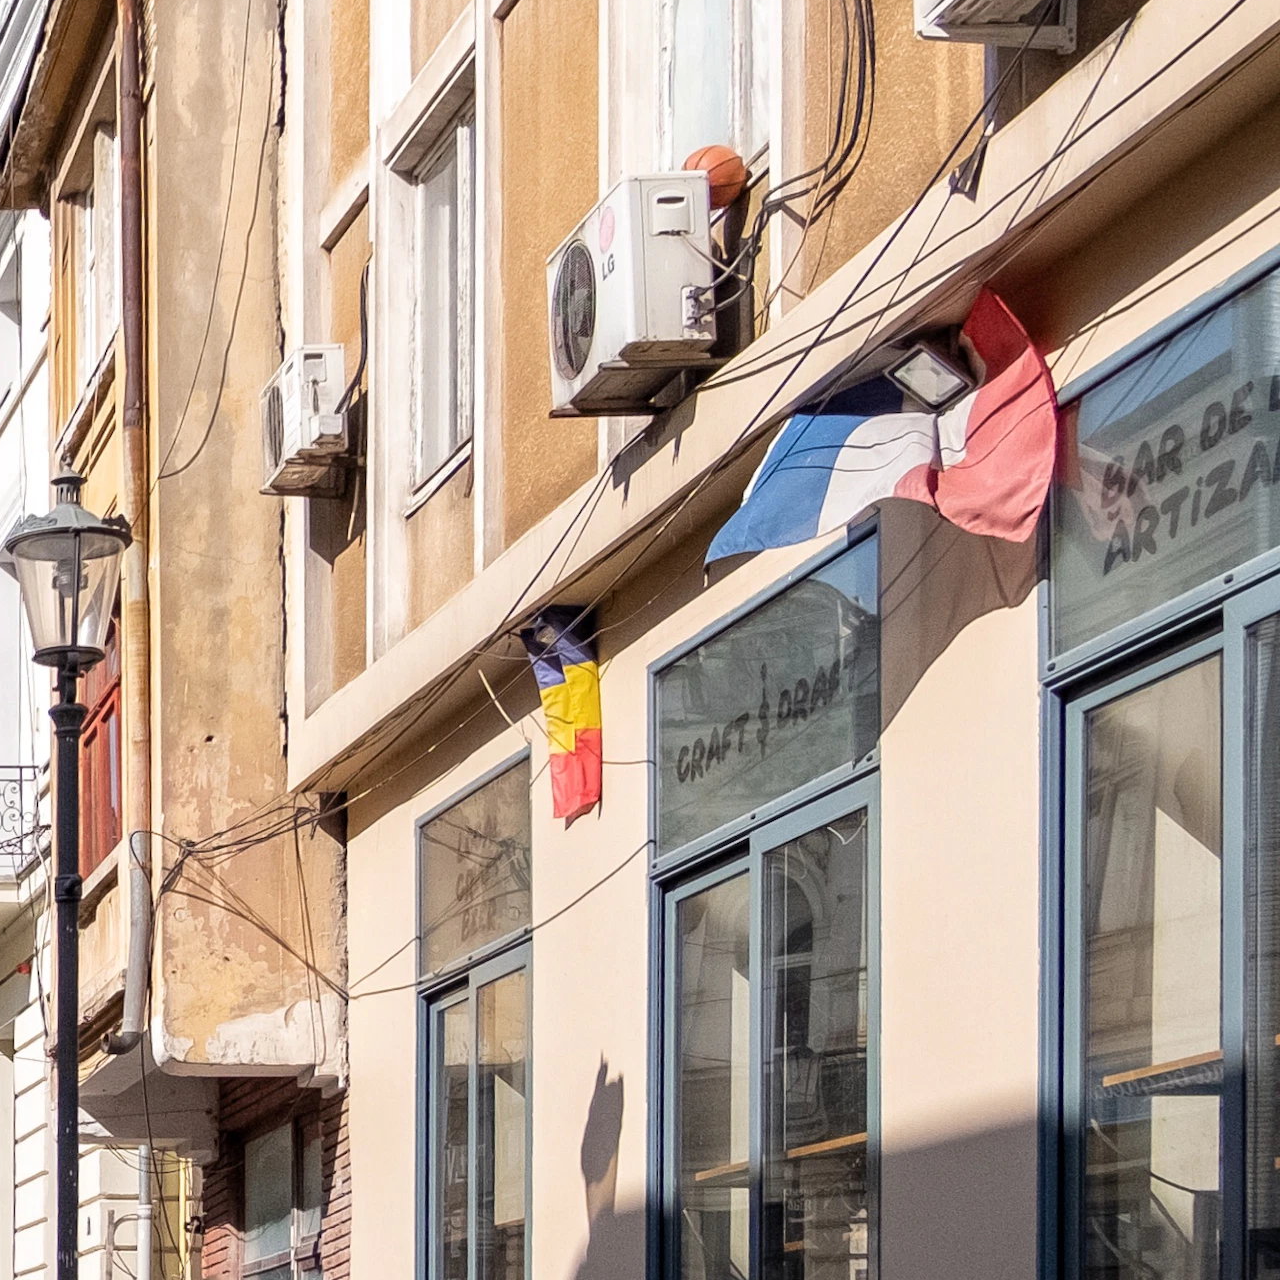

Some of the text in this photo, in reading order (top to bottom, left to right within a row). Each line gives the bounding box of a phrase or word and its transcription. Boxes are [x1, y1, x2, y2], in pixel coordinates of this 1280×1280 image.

[602, 253, 615, 281] LG
[1101, 425, 1184, 508] BAR
[1200, 381, 1253, 451] DE
[677, 712, 749, 783] CRAFT
